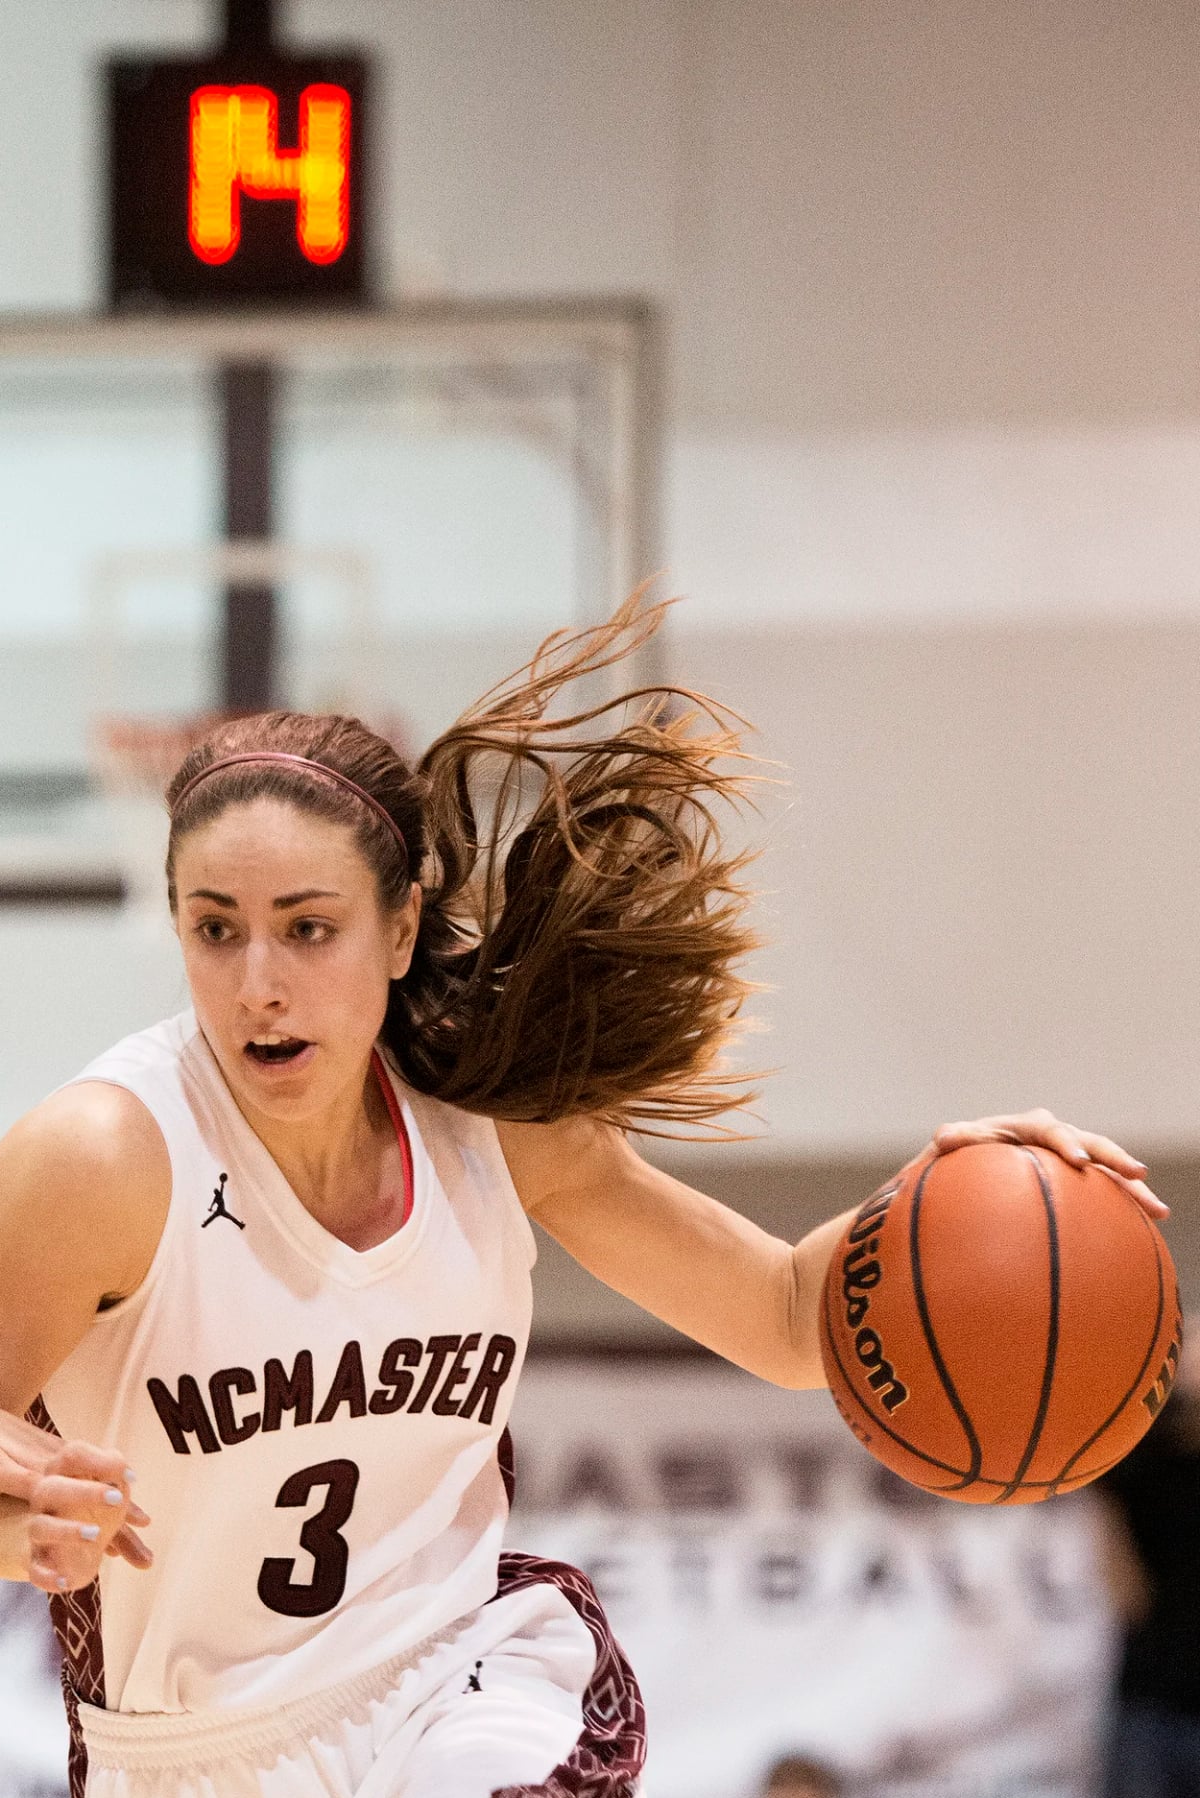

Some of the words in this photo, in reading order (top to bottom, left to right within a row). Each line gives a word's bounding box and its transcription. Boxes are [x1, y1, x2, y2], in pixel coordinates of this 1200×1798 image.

[188, 83, 351, 265] 14
[842, 1178, 911, 1417] Wilson
[146, 1332, 517, 1455] MCMASTER
[257, 1458, 360, 1619] 3
